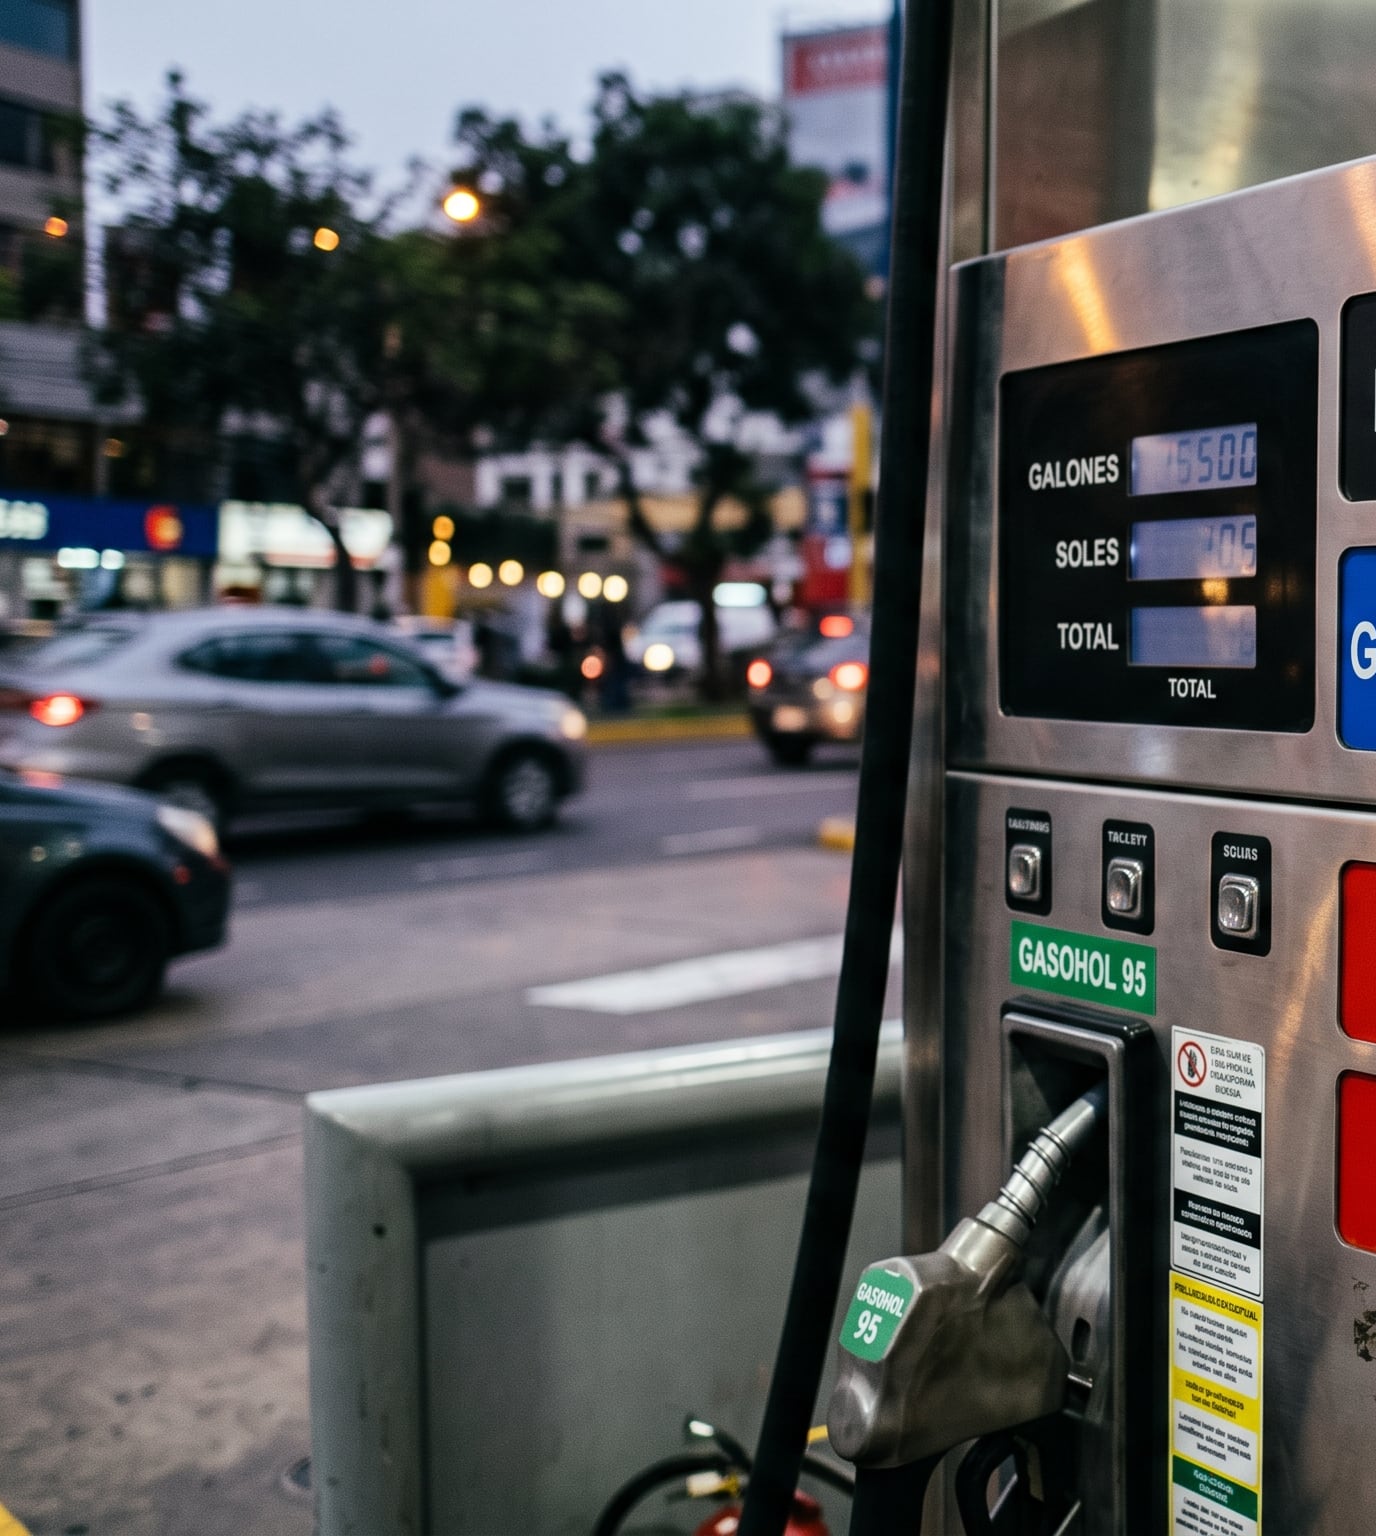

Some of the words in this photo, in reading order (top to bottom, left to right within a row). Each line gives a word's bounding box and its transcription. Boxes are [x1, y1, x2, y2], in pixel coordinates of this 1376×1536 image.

[1028, 454, 1120, 491] GALONES
[1055, 537, 1120, 569] SOLES
[1057, 622, 1120, 650] TOTAL
[1167, 677, 1217, 699] TOTAL
[1018, 936, 1117, 991] GASOHOL
[1122, 957, 1147, 997] 95
[856, 1282, 905, 1318] GASOHOL
[853, 1310, 883, 1345] 95
